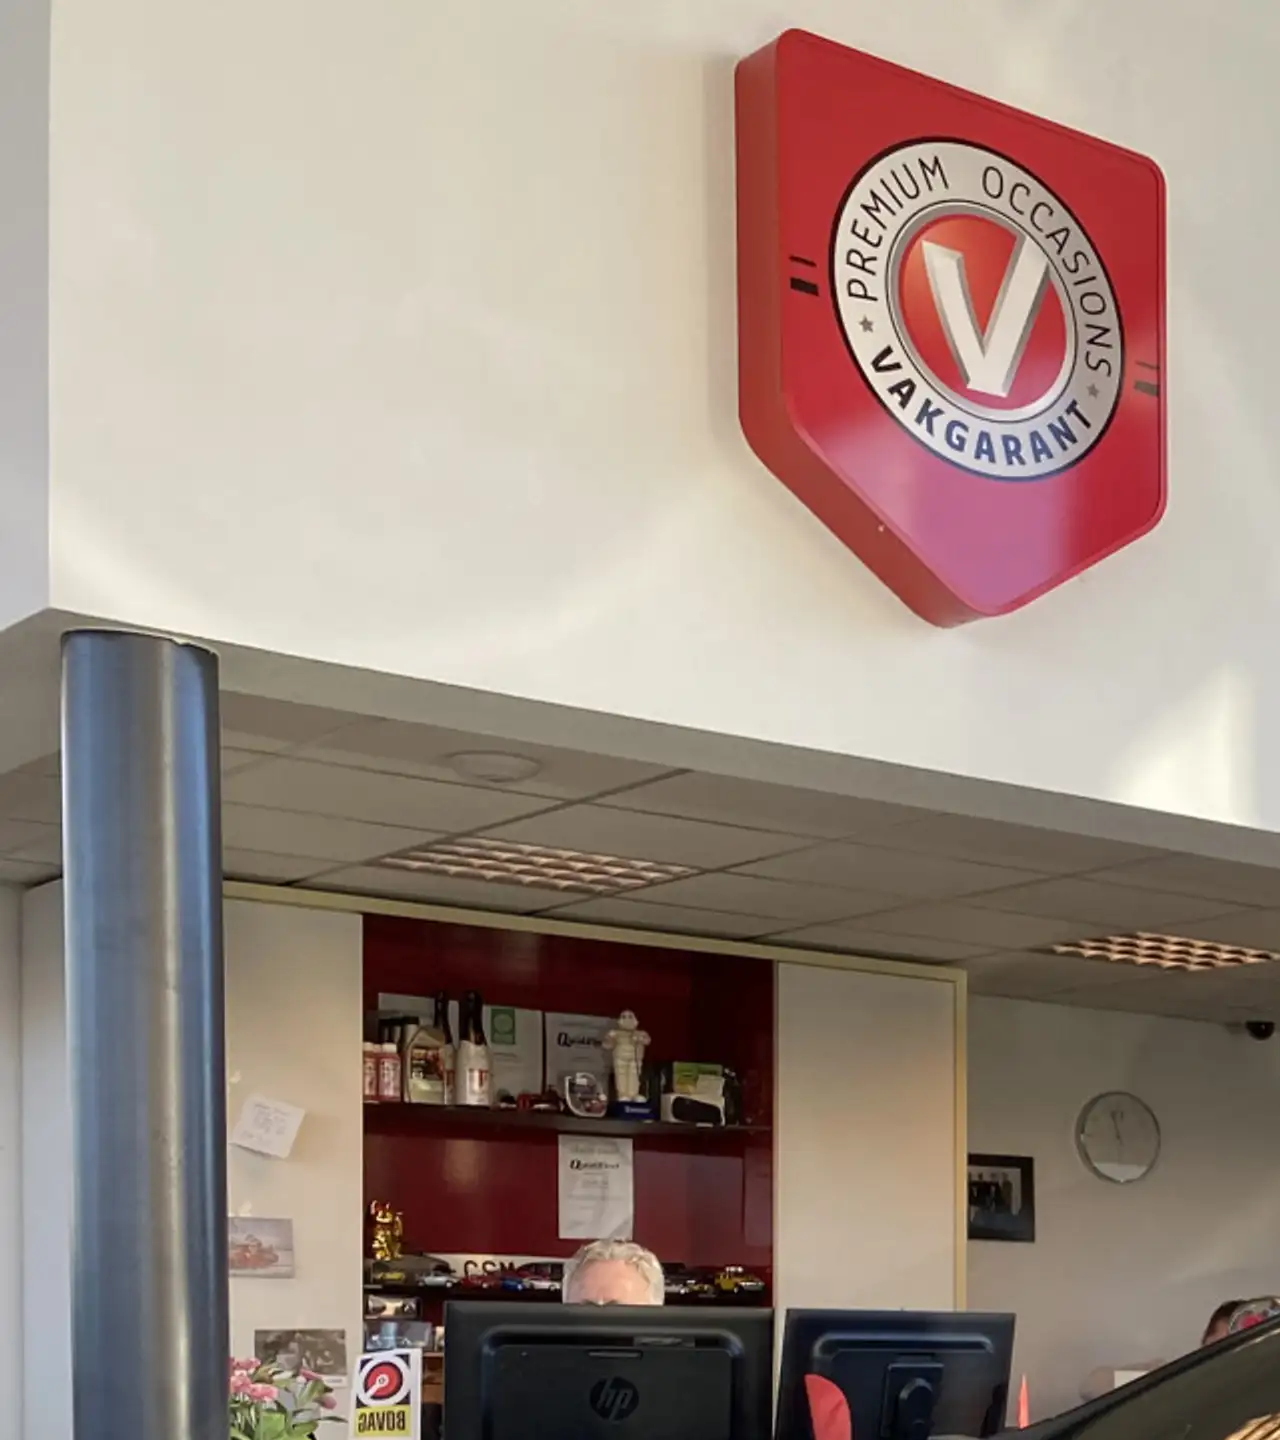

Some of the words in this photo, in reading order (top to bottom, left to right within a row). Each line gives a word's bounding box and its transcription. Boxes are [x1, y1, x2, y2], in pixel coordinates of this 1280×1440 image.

[847, 155, 949, 302] PREMIUM
[981, 165, 1112, 378] OCCASIONS
[921, 234, 1052, 398] V
[871, 346, 1093, 466] VAKGARANT
[597, 1376, 634, 1421] hp
